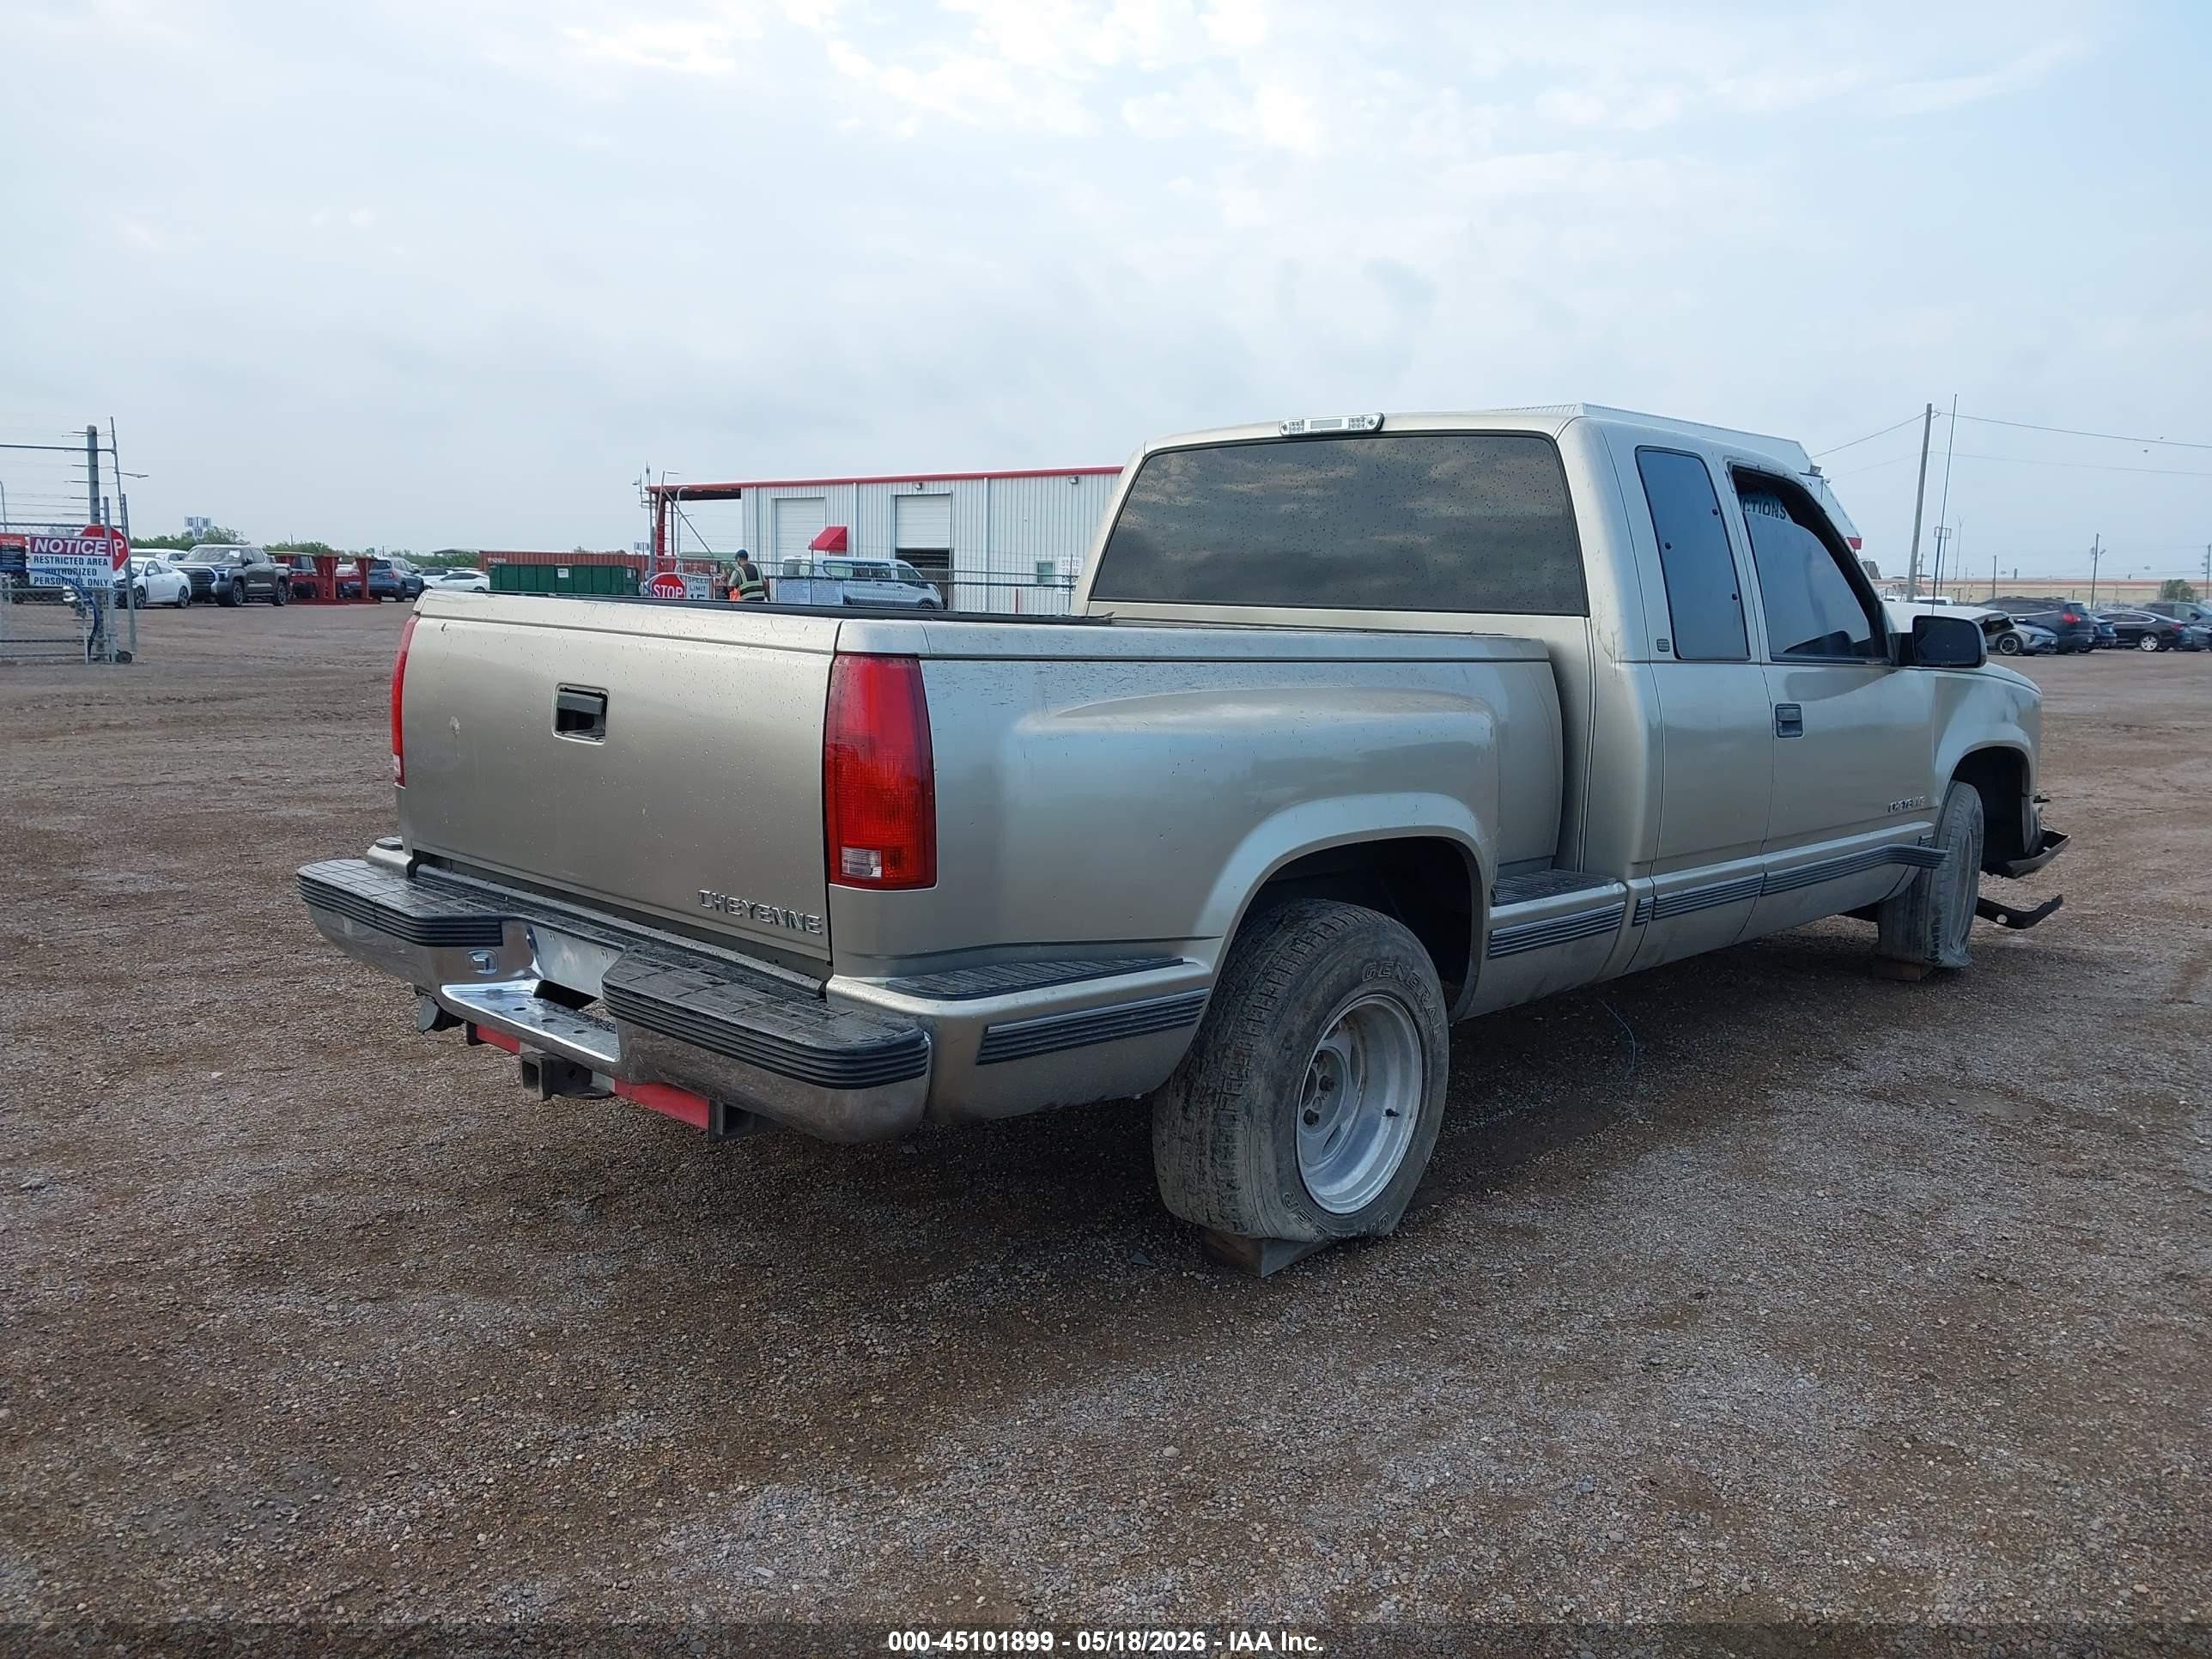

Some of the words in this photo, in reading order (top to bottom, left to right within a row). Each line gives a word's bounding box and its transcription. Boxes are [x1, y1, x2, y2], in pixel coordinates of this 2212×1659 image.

[1738, 498, 1787, 520] CTIONS
[33, 538, 107, 555] NOTICE
[33, 556, 84, 566] RESTRICTED
[87, 557, 108, 567] AREA
[45, 567, 97, 576] AUTHORIZED
[33, 577, 84, 586] PERSONNEL
[653, 584, 684, 599] STOP
[698, 890, 823, 935] CHEYENNE
[1361, 961, 1442, 1045] GENERAL
